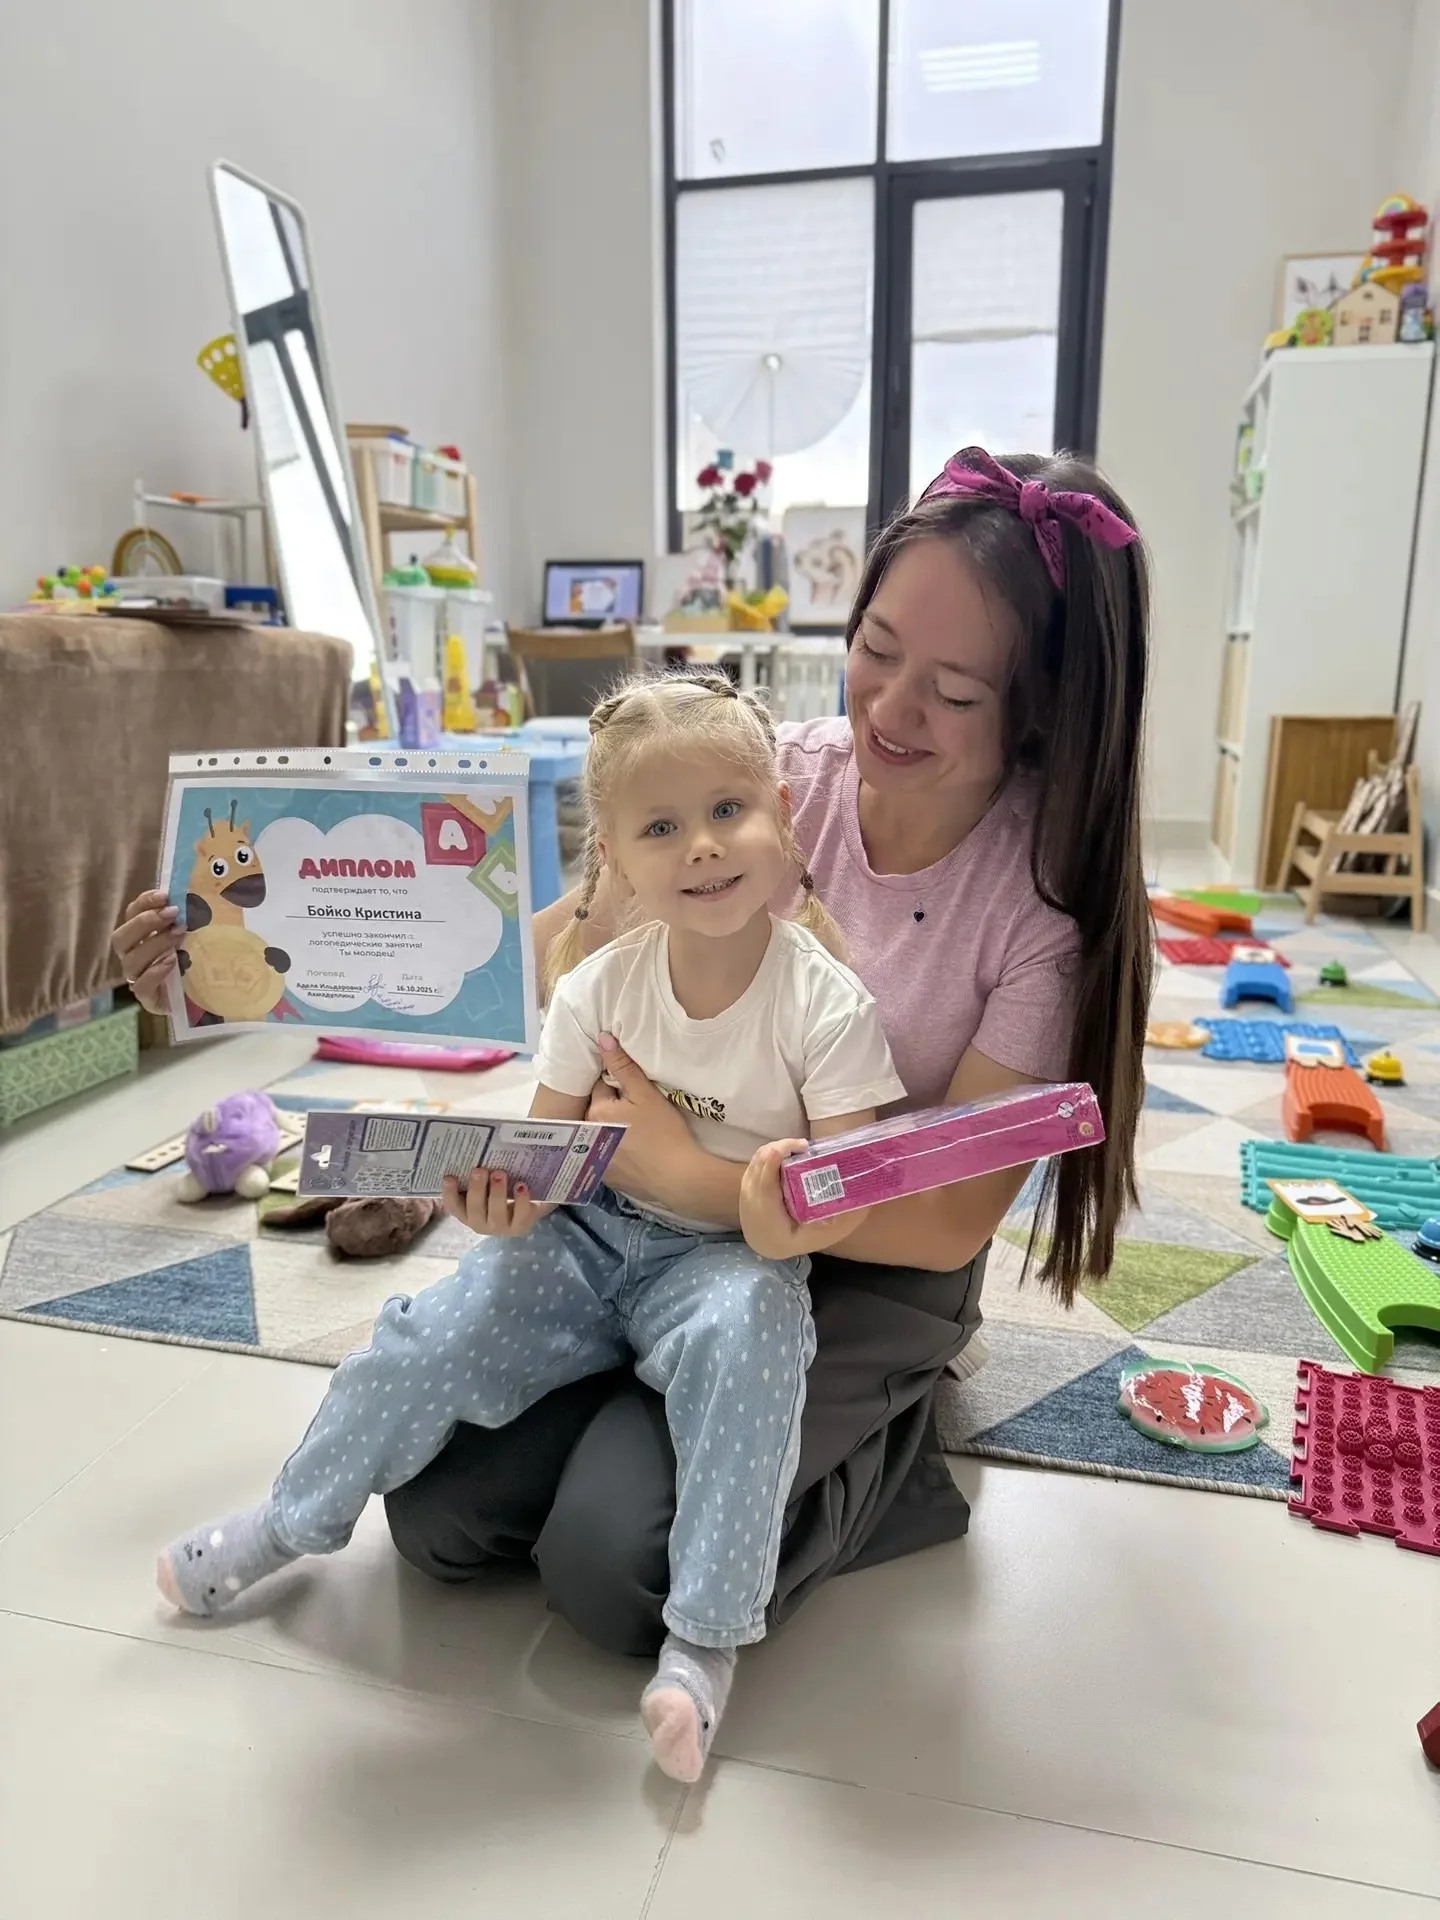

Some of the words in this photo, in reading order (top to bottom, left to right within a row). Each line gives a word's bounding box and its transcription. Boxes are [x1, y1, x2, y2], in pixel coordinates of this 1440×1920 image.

[299, 858, 416, 879] ДИПЛОМ
[312, 886, 377, 895] подтверждает
[379, 888, 391, 896] то,
[307, 905, 351, 918] Бойко
[355, 907, 422, 920] Кристина
[321, 931, 362, 939] успешно
[308, 939, 383, 949] логопедические
[353, 950, 395, 958] молодец!
[396, 985, 433, 994] 16.10.2025
